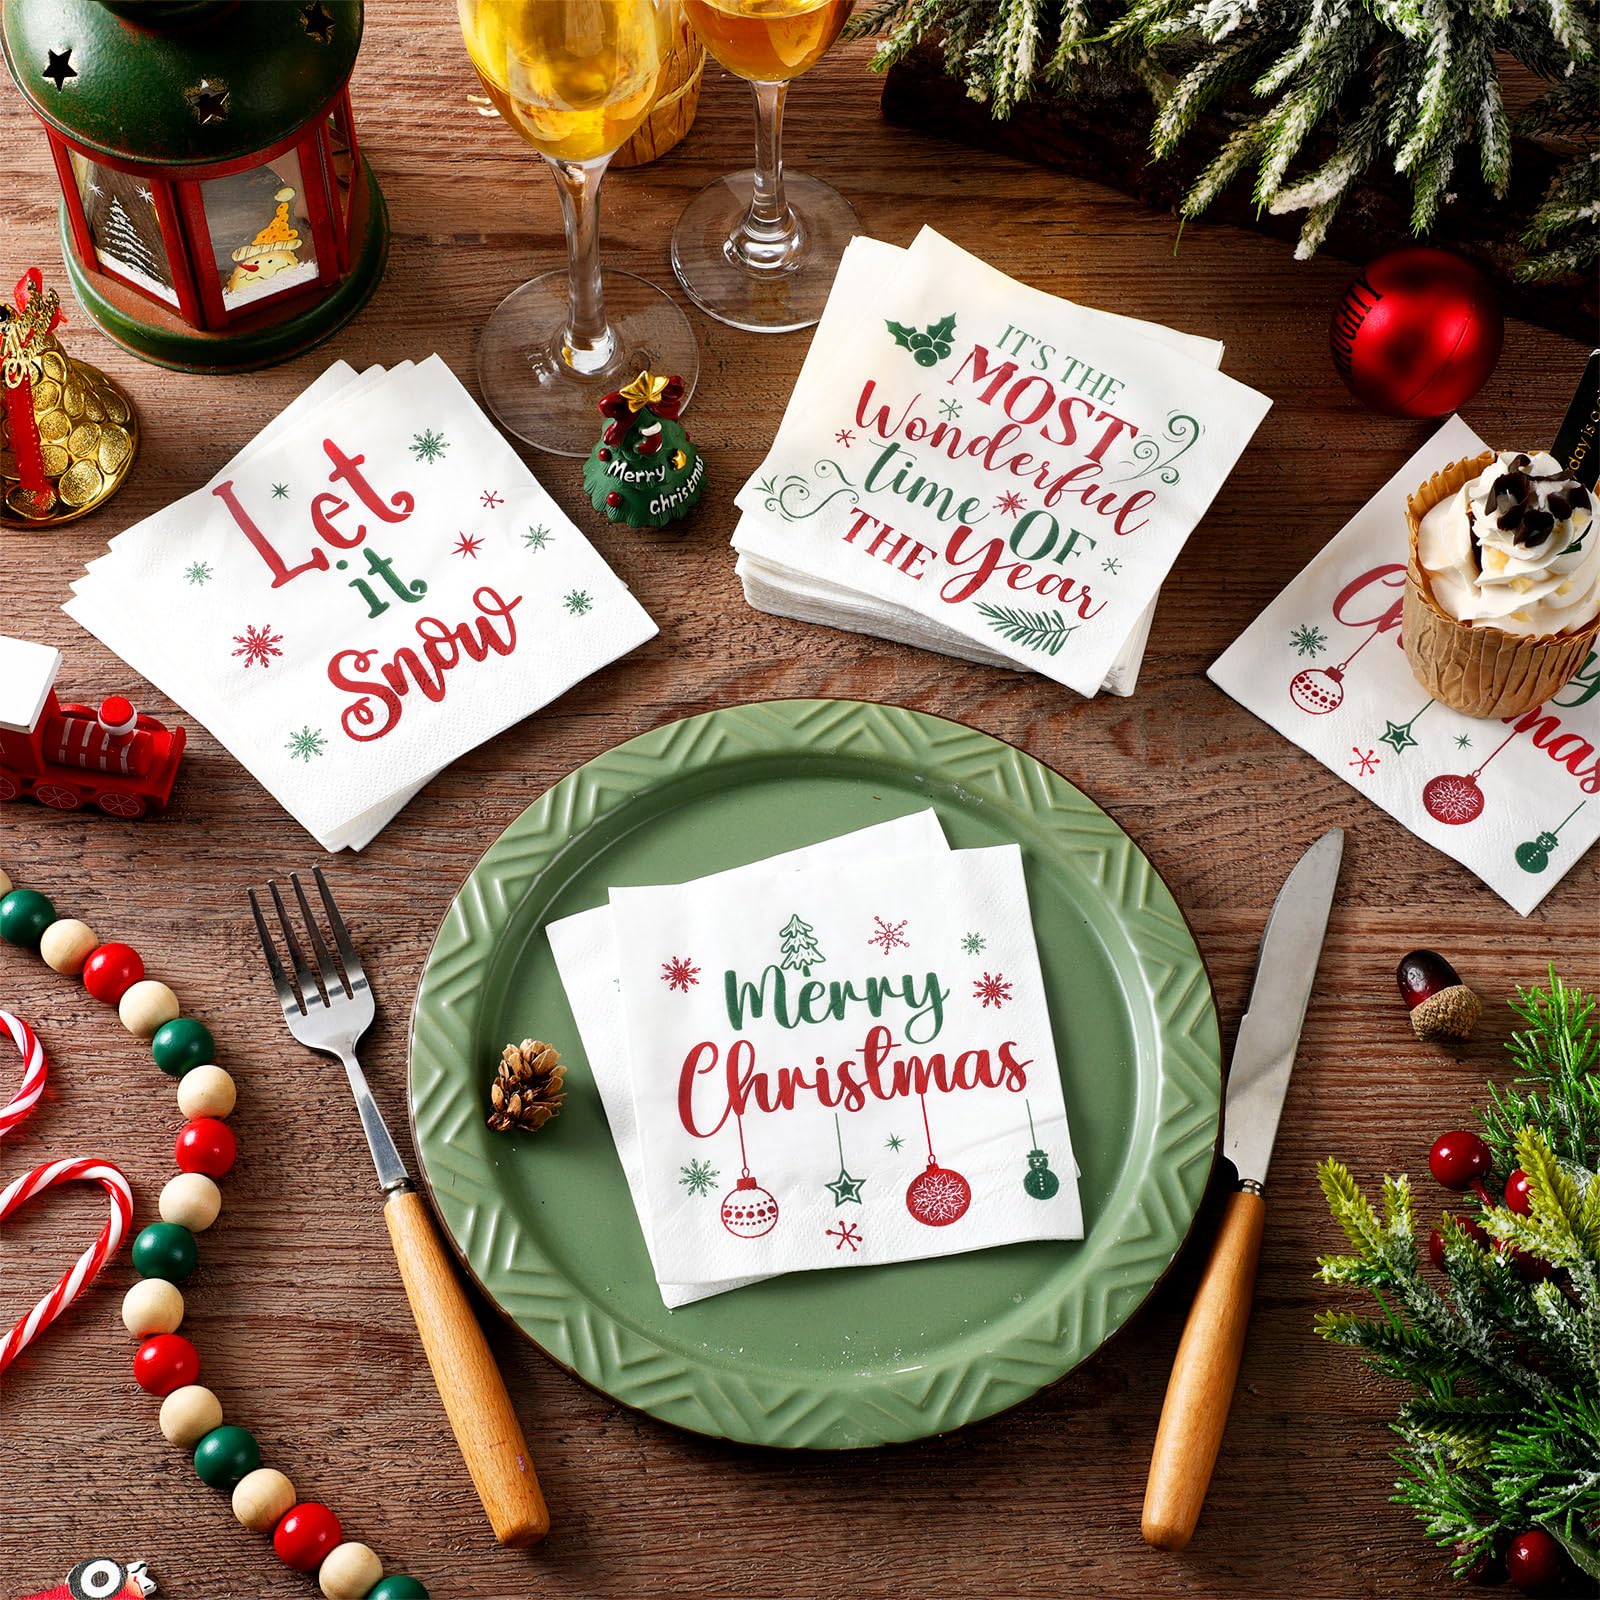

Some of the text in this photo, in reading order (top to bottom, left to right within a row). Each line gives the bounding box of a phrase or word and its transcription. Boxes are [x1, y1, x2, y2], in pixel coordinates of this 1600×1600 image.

[946, 343, 1139, 463] MOST
[994, 323, 1126, 407] IT'S THE
[212, 438, 416, 590] Let
[607, 460, 666, 482] Merry
[855, 379, 1157, 536] Wonderful
[865, 441, 1098, 567] time OF
[335, 547, 429, 620] it
[841, 506, 939, 582] THE
[326, 586, 523, 743] Snow
[724, 964, 950, 1044] Merry
[677, 1025, 1035, 1138] Christmas
